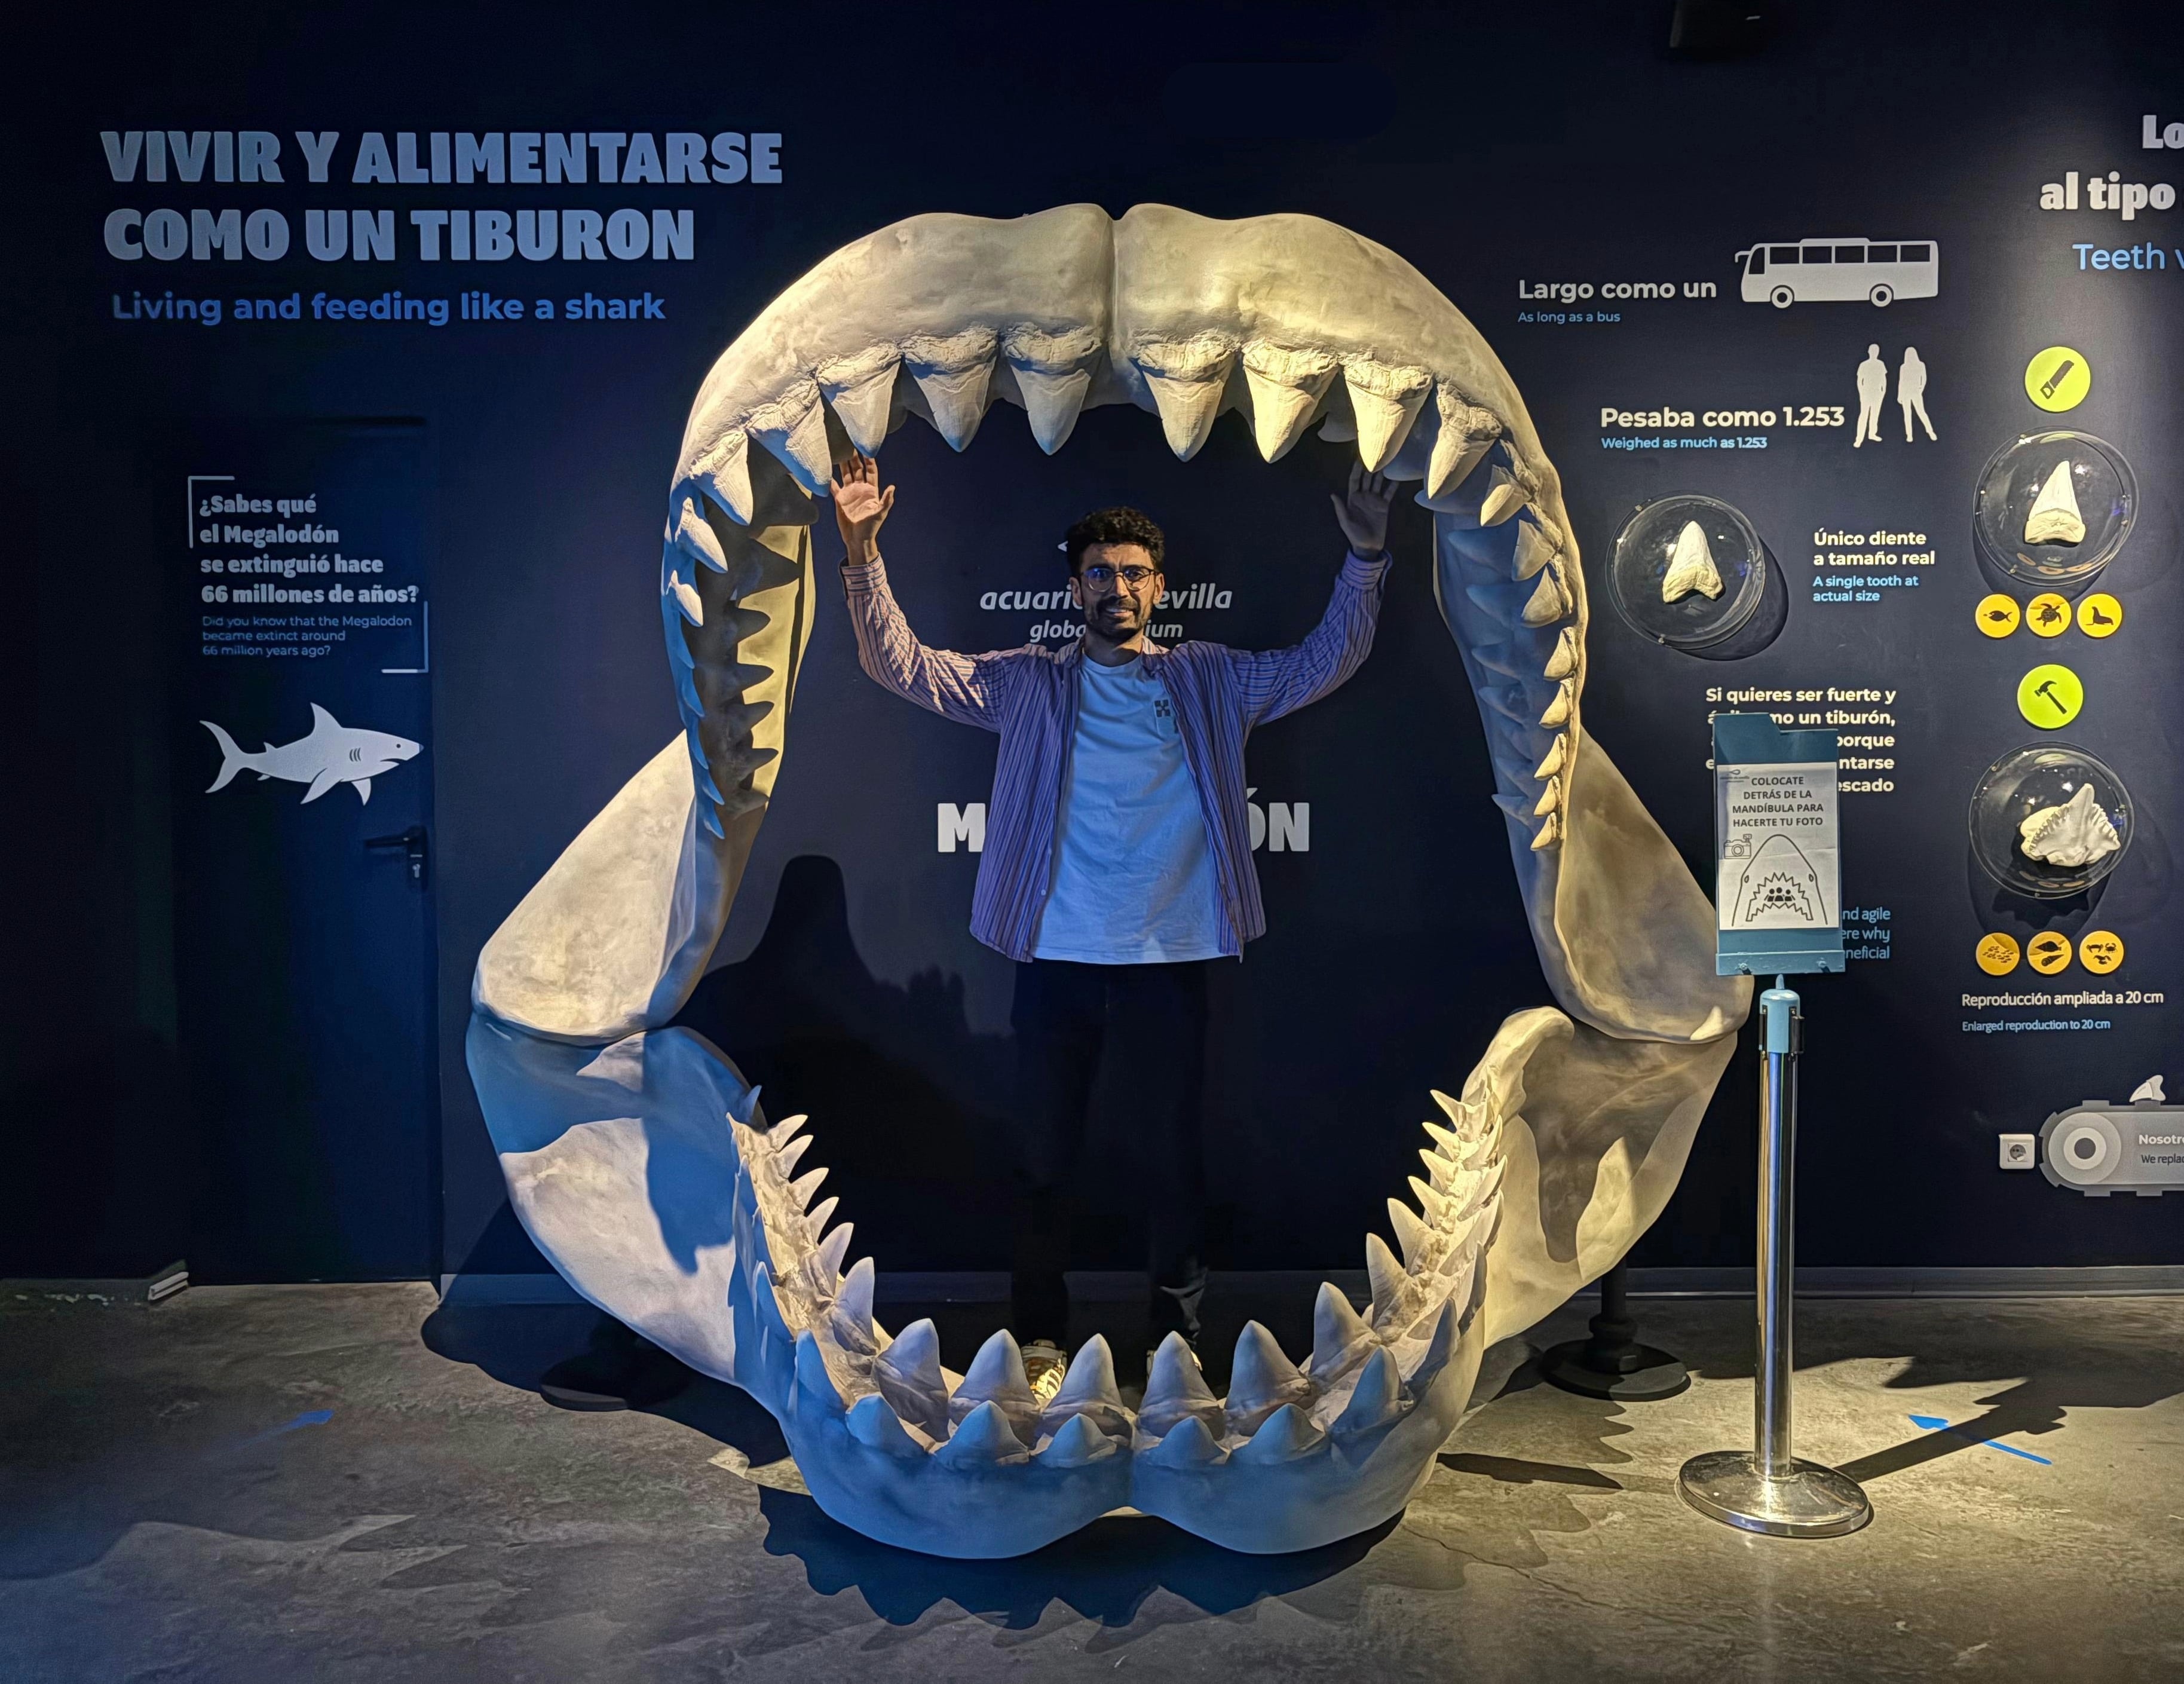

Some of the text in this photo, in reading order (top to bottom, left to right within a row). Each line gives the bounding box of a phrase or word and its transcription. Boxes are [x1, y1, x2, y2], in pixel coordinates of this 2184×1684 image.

[100, 131, 782, 183] VIVIR Y ALIMENTARSE
[2040, 172, 2175, 221] al tipo
[104, 209, 694, 261] COMO UN TIBURON
[2072, 242, 2165, 270] Teeth
[1520, 280, 1716, 303] Largo como un
[114, 291, 666, 326] Living and feeding like a shark
[1518, 312, 1533, 322] As
[1537, 311, 1565, 324] long
[1597, 311, 1621, 322] bus
[1601, 407, 1845, 427] Pesaba como 1.253
[1601, 437, 1767, 451] Weighed as much as 1.253
[200, 494, 316, 518] ¿Sabes qué
[200, 523, 339, 548] el Megalodón
[1815, 528, 1926, 546] Único diente
[201, 553, 383, 578] se extinguió hace
[1814, 550, 1935, 565] a tamaño real
[1813, 575, 1919, 589] A single tooth at
[201, 584, 419, 604] 66 millones de años?
[1154, 583, 1233, 609] evilla
[1813, 590, 1880, 601] actual size
[203, 616, 412, 628] Did you know that the Megalodon
[203, 630, 345, 641] became extinct around
[1030, 620, 1086, 643] globa
[203, 645, 330, 657] 66 million years ago?
[1706, 687, 1896, 705] Si quieres ser fuerte y
[1799, 714, 1821, 724] un
[1825, 710, 1895, 727] tiburón,
[1839, 757, 1894, 769] ntarse
[1751, 777, 1804, 785] COLOCATE
[1839, 778, 1894, 792] scado
[1744, 789, 1781, 799] DETRÁS
[1733, 803, 1794, 813] MANDÍBULA
[1842, 907, 1891, 923] nd agile
[1862, 926, 1890, 942] why
[1845, 945, 1890, 959] neficial
[1962, 990, 2163, 1009] Reproducción ampliada a 20 cm
[1963, 1020, 2004, 1033] Enlarged
[2005, 1019, 2068, 1033] reproduction
[2070, 1021, 2080, 1029] to
[2081, 1019, 2093, 1029] 20
[2139, 1135, 2184, 1144] Nosotr
[2141, 1155, 2155, 1164] We
